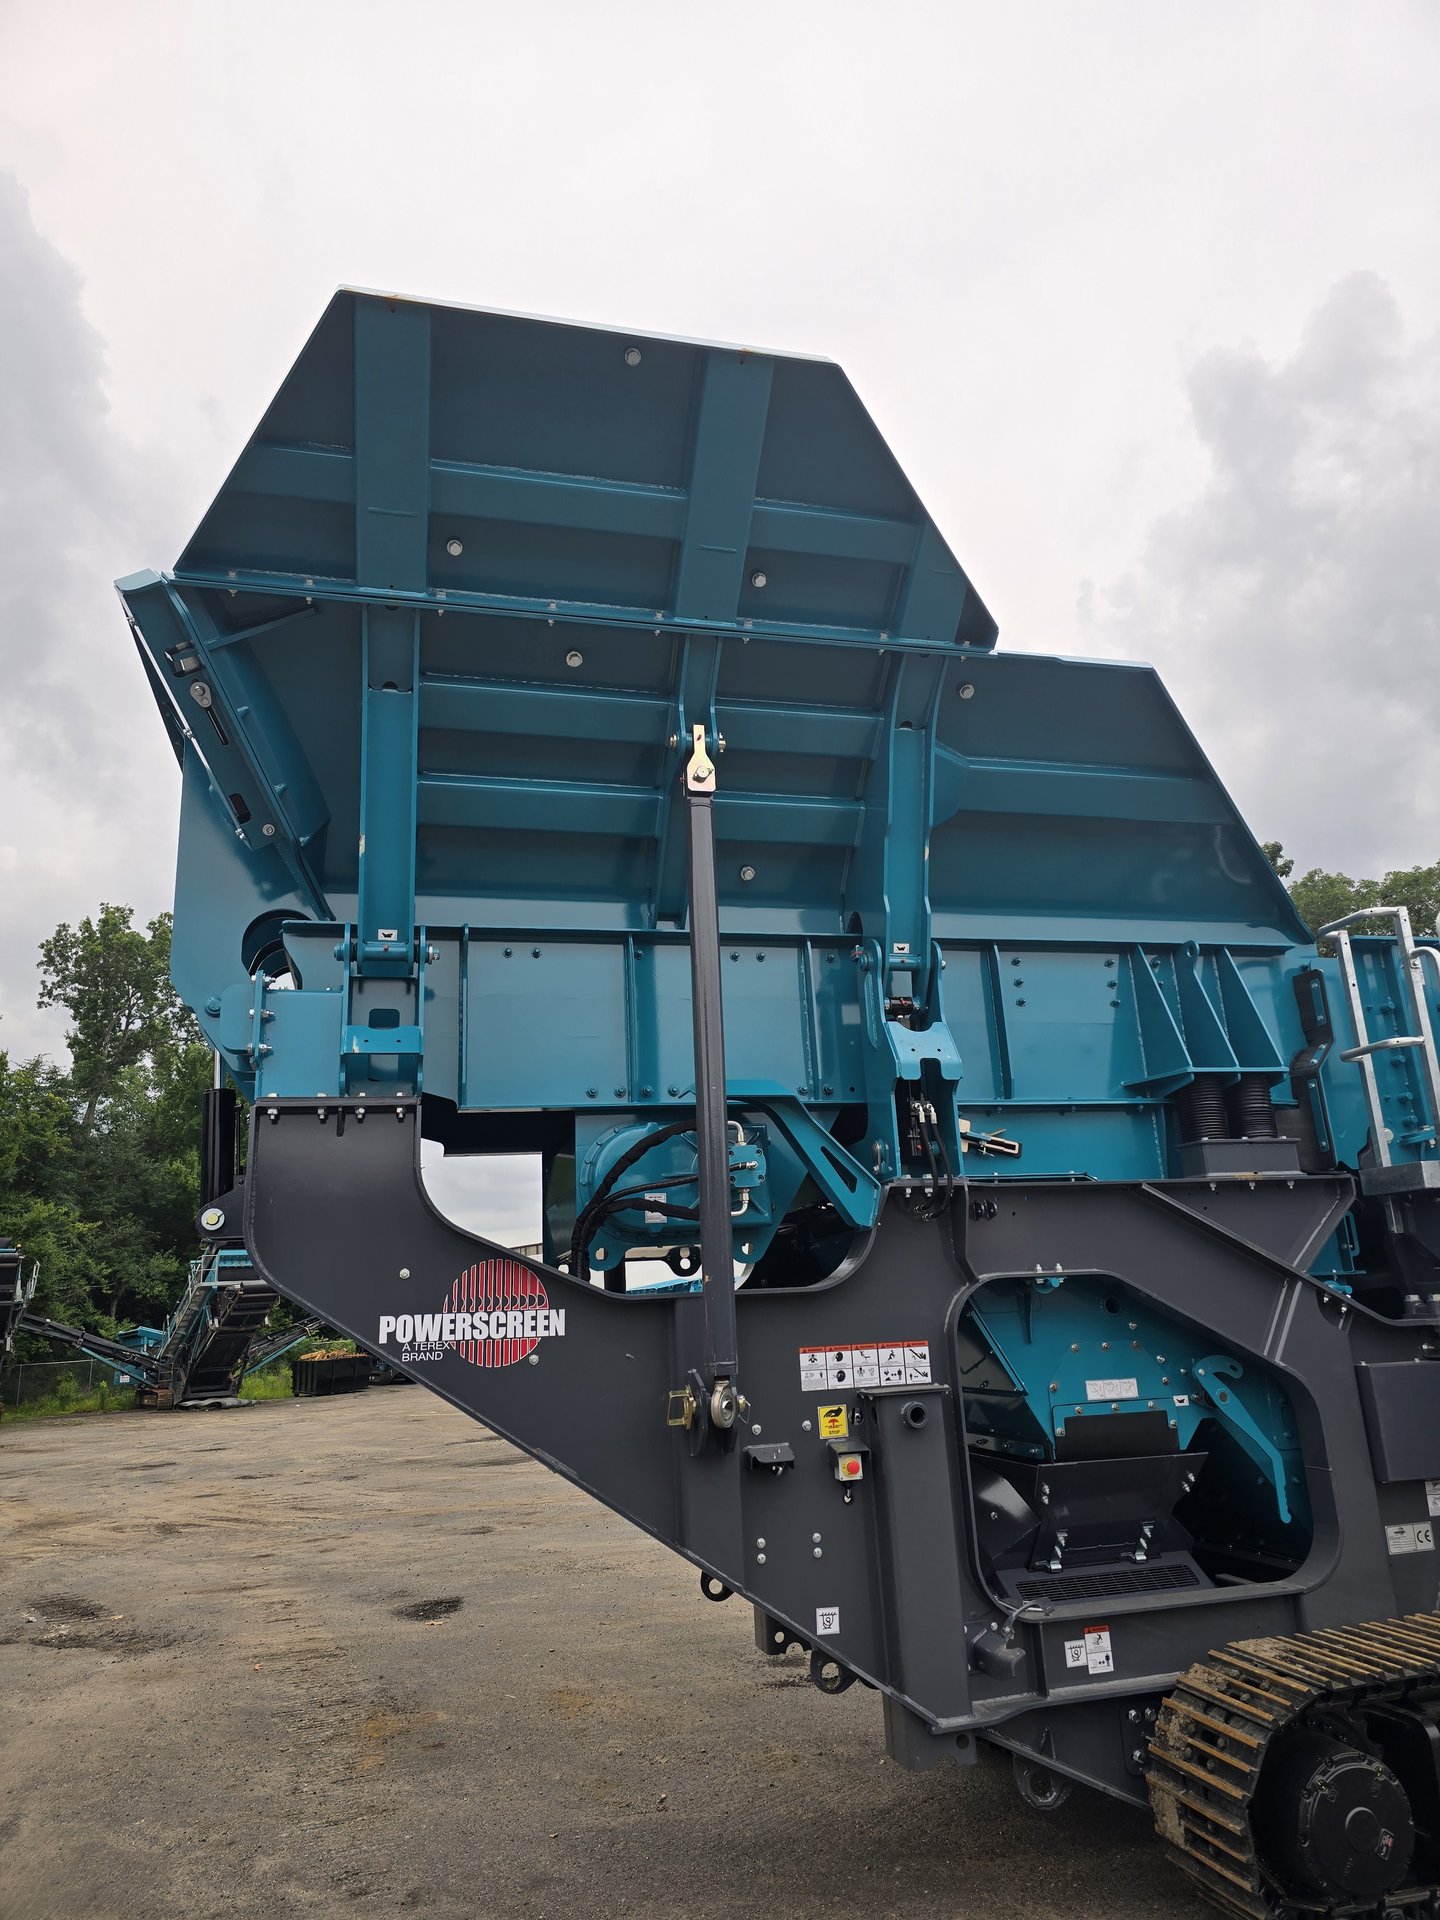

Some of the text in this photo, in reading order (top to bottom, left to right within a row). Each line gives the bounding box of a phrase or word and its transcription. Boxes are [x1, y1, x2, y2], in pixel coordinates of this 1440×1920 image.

[379, 1309, 565, 1344] POWERSCREEN
[402, 1341, 450, 1351] A TEREX
[402, 1351, 443, 1362] BRAND
